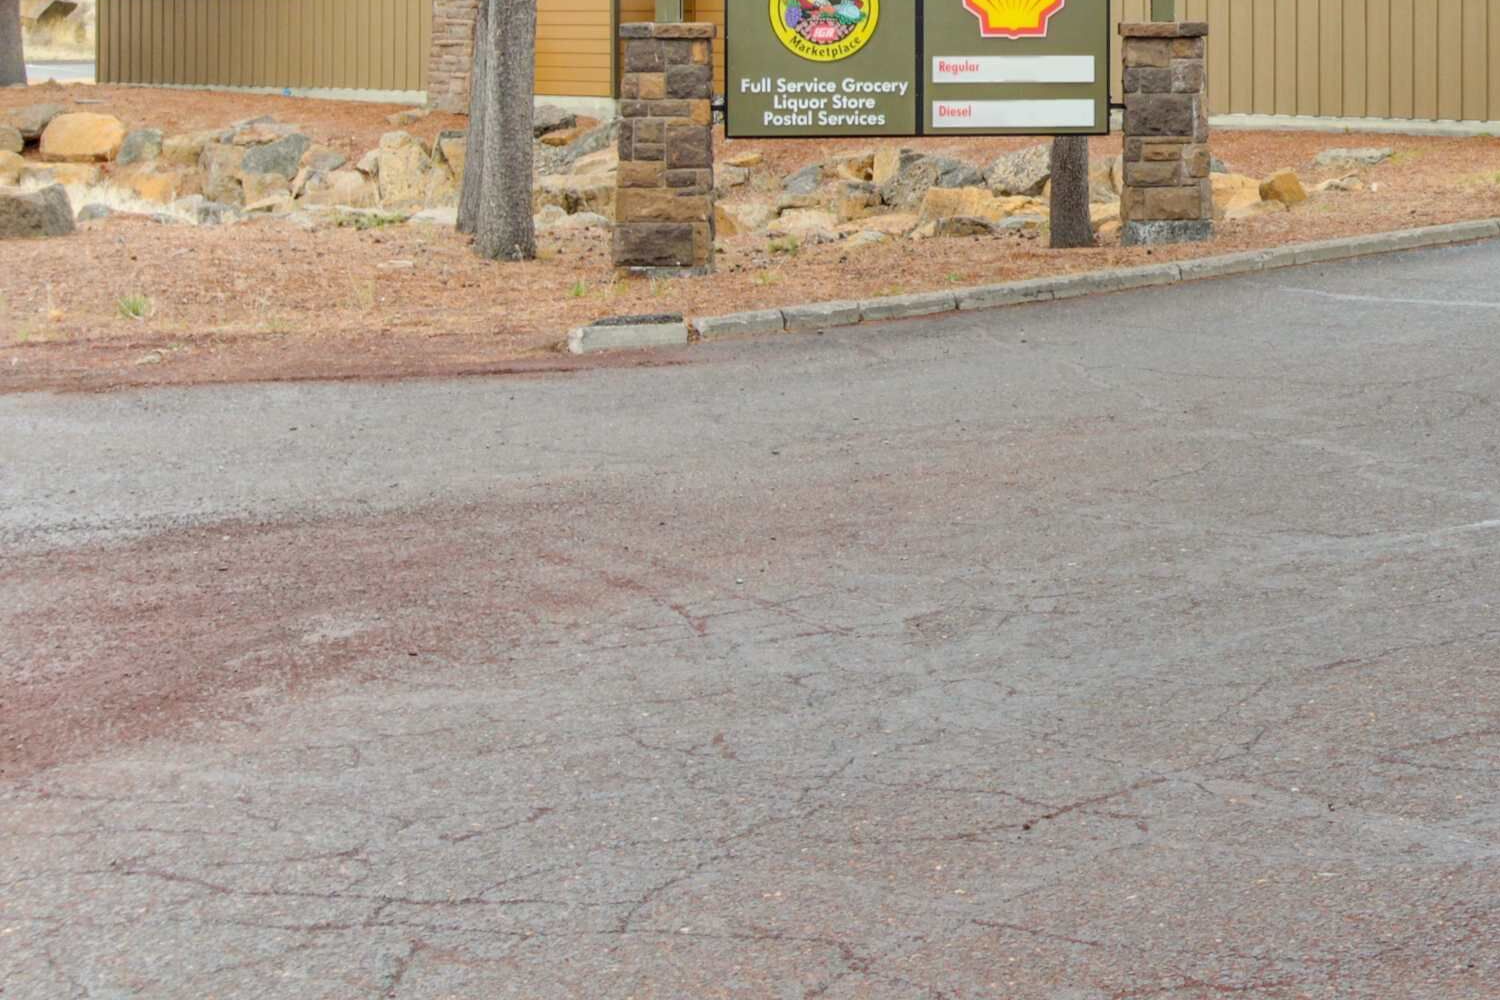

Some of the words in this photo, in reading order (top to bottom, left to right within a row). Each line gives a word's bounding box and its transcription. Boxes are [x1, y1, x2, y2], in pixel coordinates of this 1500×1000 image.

[790, 36, 862, 58] Marketplace
[938, 60, 980, 75] Regular
[740, 78, 771, 93] Full
[777, 78, 836, 93] Service
[842, 78, 909, 96] Grocery
[773, 95, 828, 112] Liquor
[832, 94, 876, 109] Store
[938, 104, 972, 117] Diesel
[763, 111, 813, 126] Postal
[818, 111, 886, 126] Services
